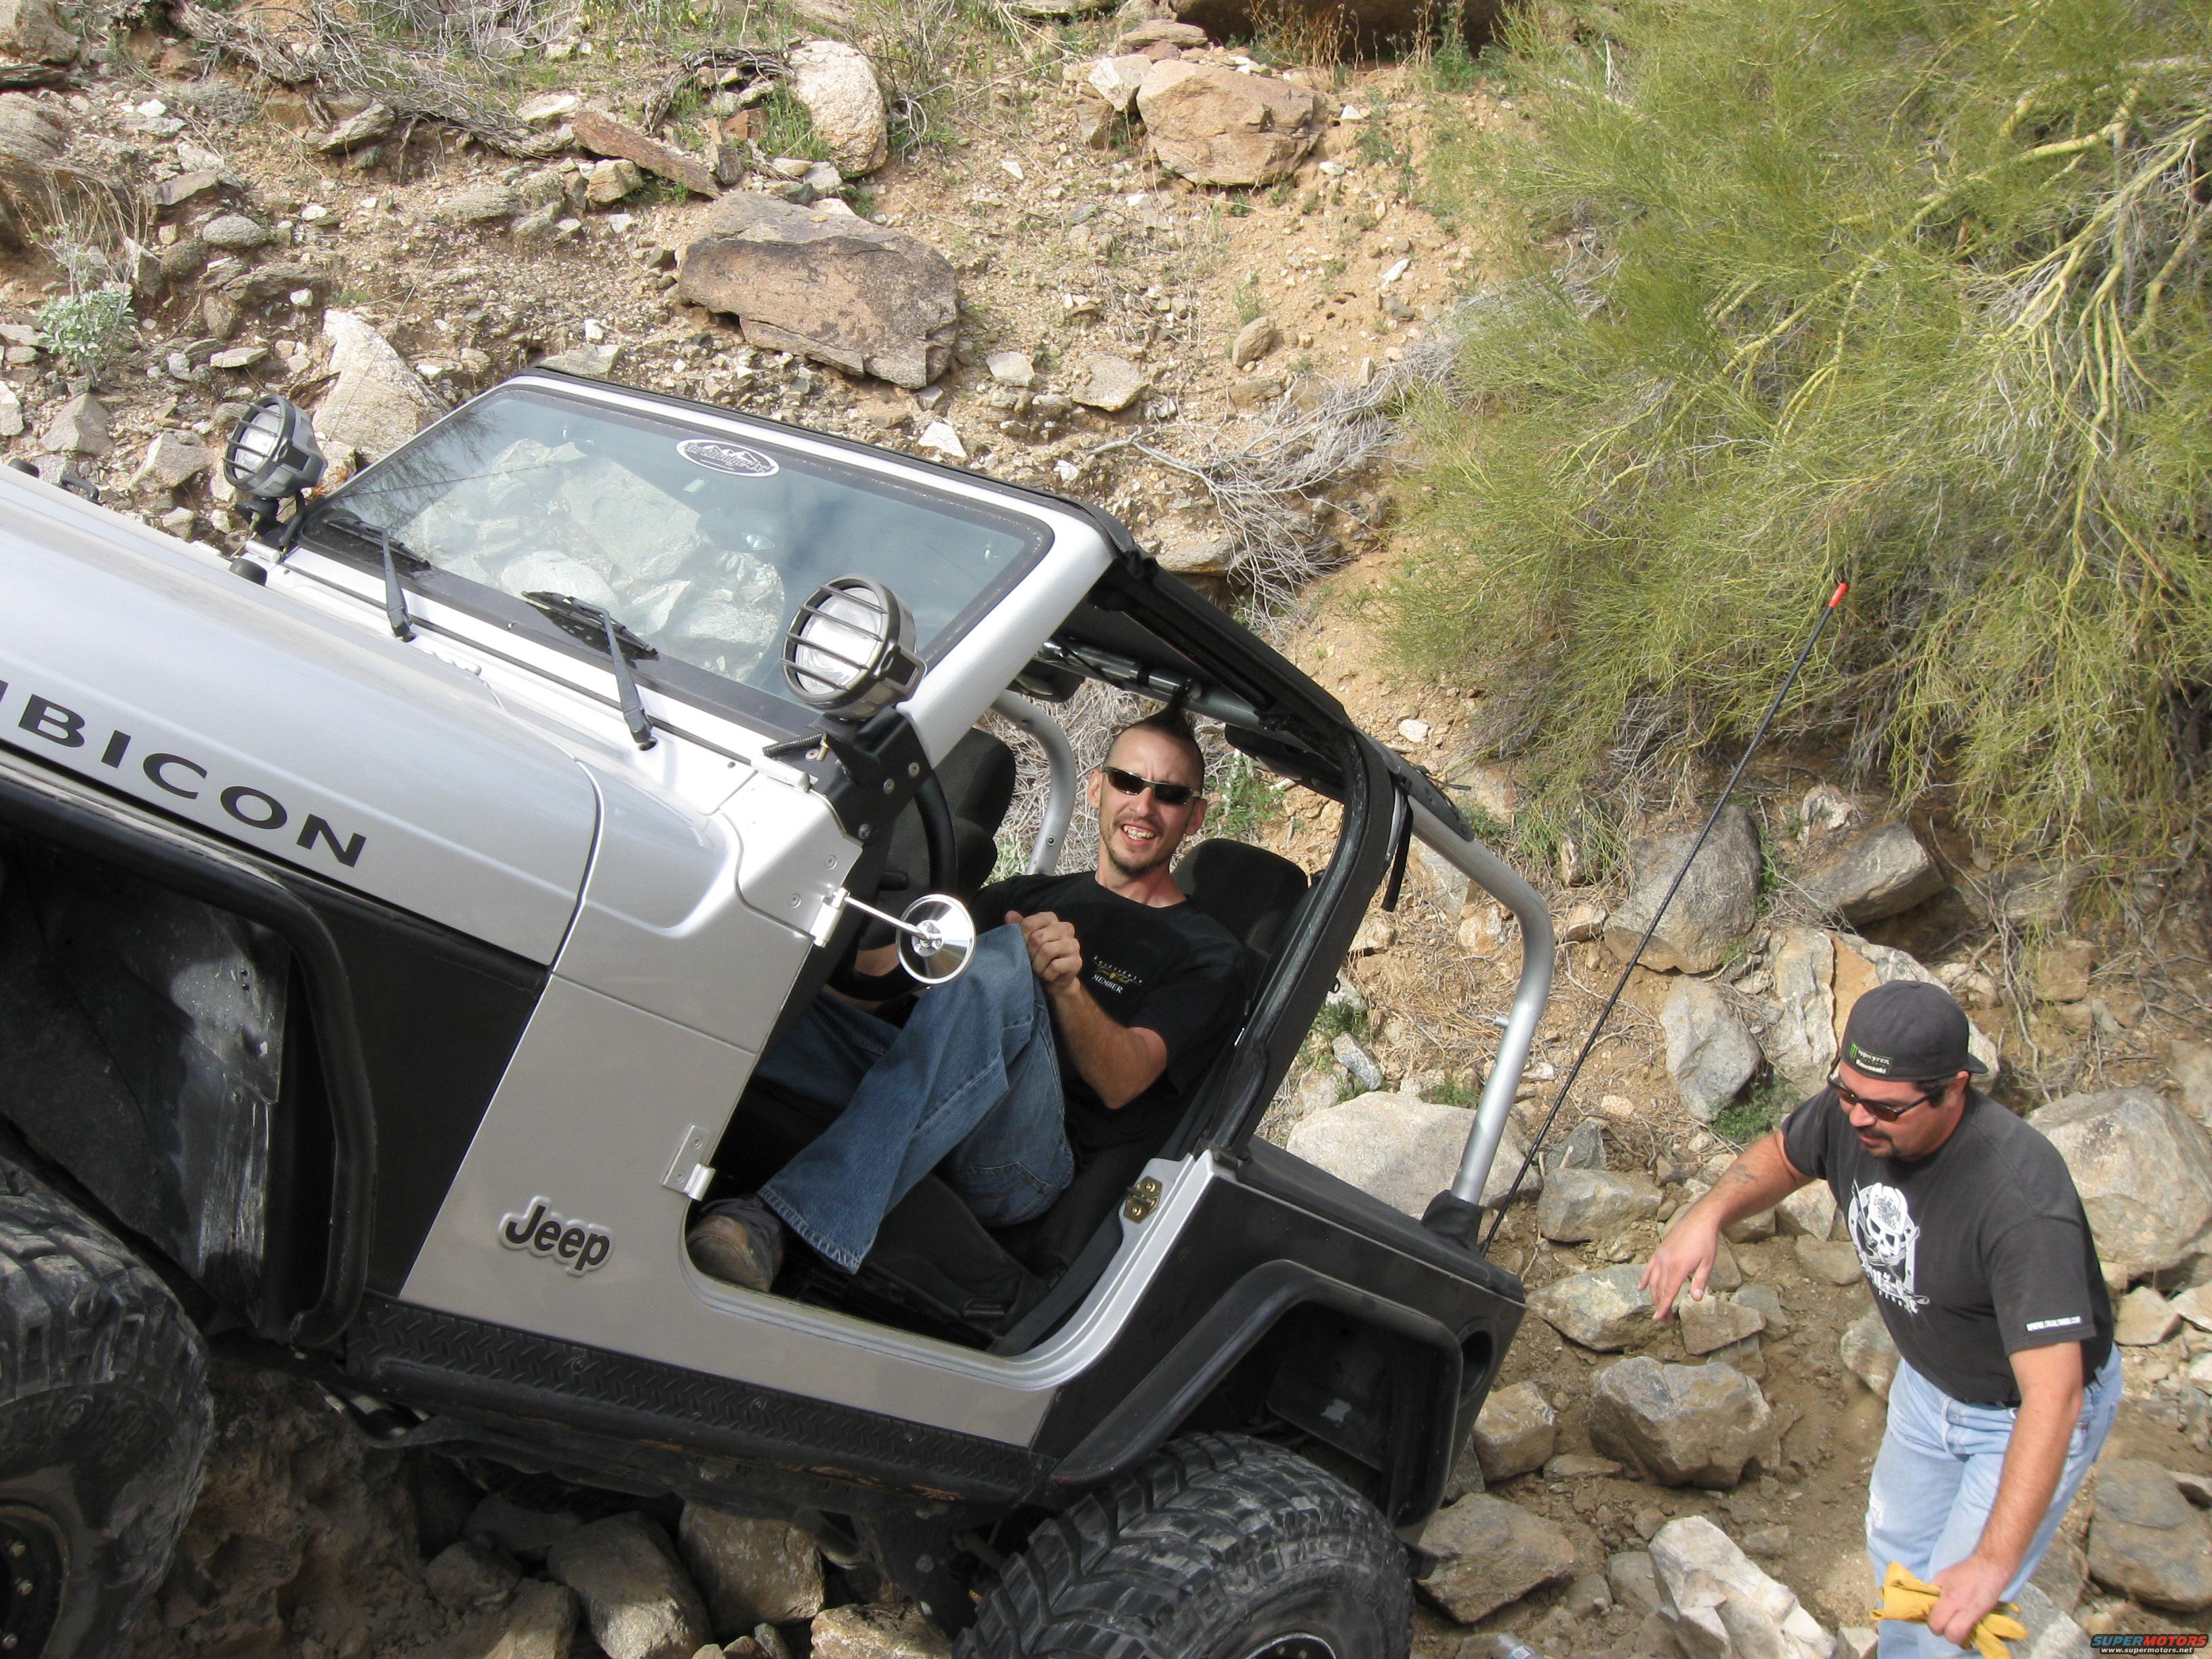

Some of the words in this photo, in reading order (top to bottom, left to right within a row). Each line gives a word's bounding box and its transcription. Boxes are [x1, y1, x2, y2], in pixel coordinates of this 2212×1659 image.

[0, 680, 366, 867] BICON
[1092, 974, 1124, 994] MEMBER
[505, 1204, 610, 1271] Jeep
